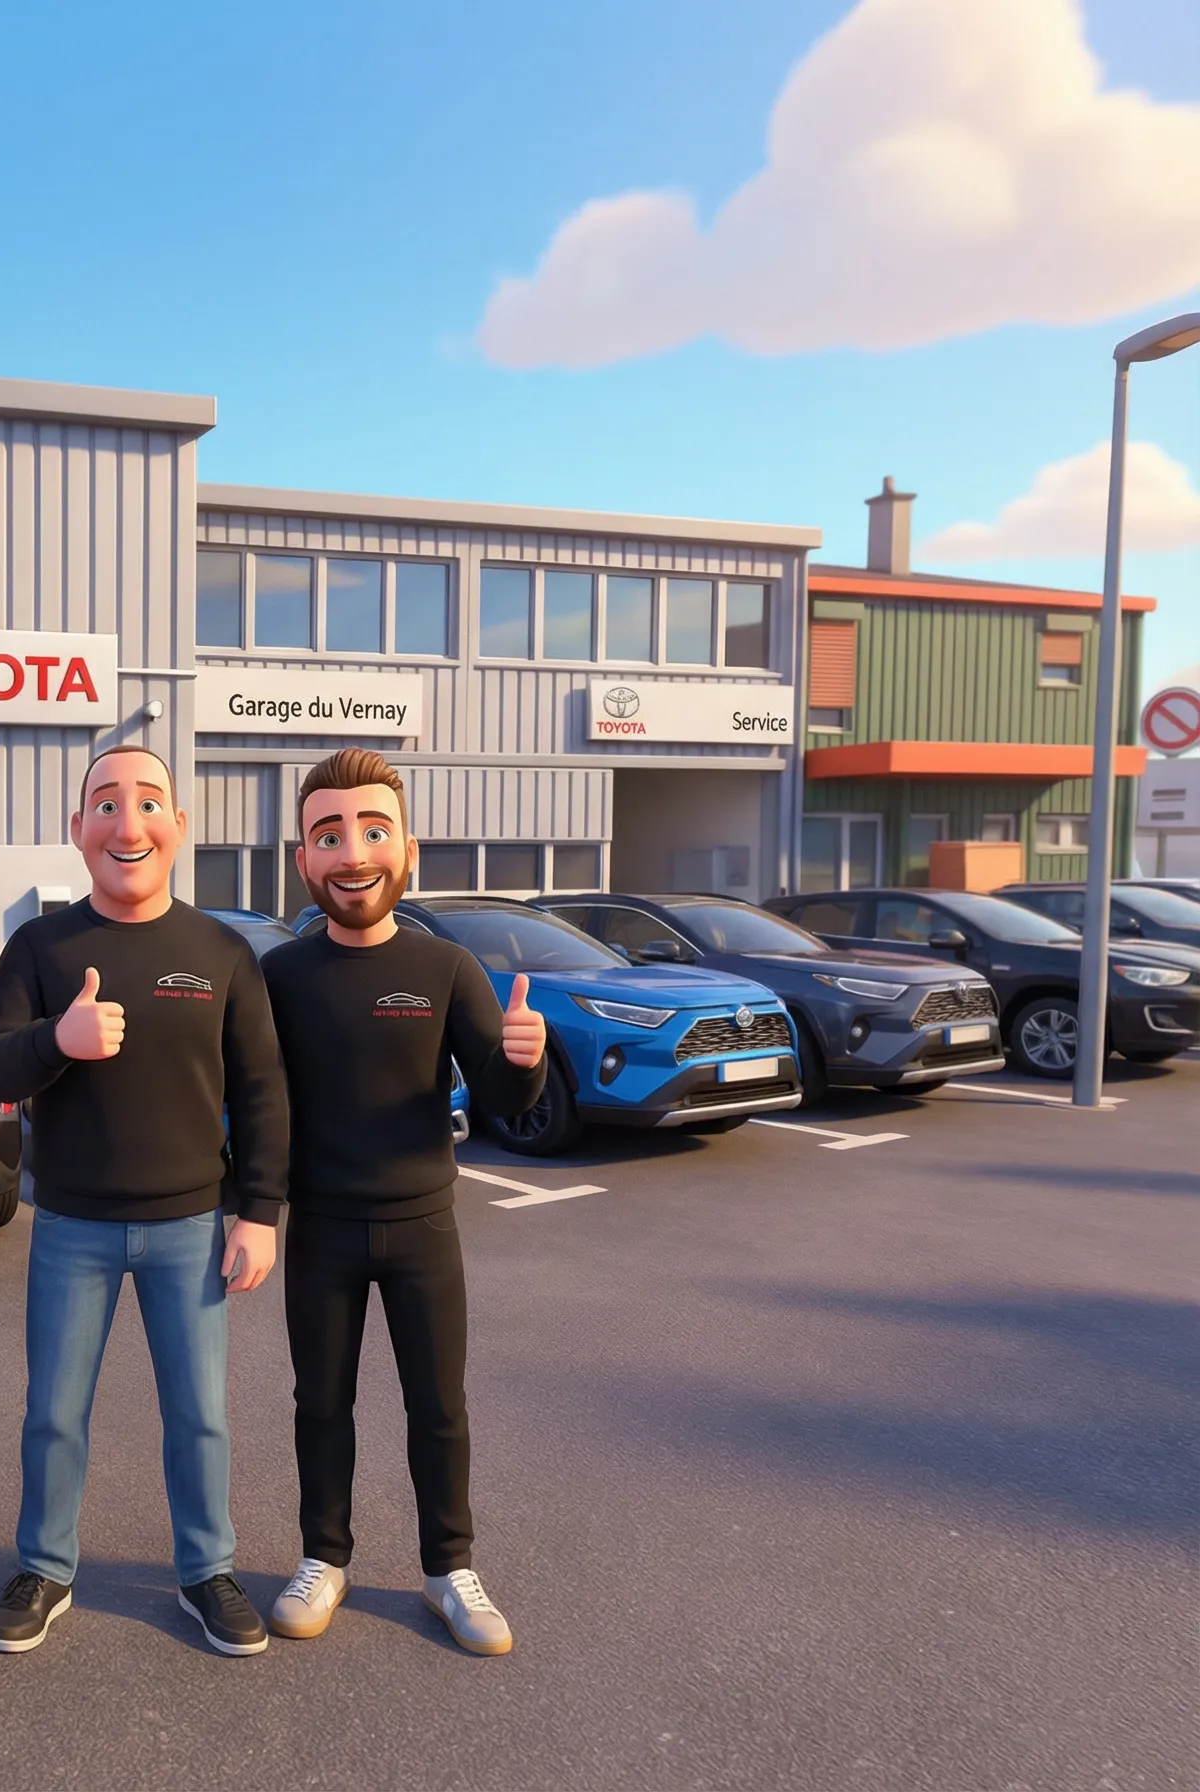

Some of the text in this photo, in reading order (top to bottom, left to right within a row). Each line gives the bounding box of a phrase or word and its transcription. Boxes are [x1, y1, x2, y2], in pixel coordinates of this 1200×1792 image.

[228, 694, 407, 726] Garage du Vernay
[596, 721, 646, 734] TOYOTA
[732, 712, 788, 732] Service
